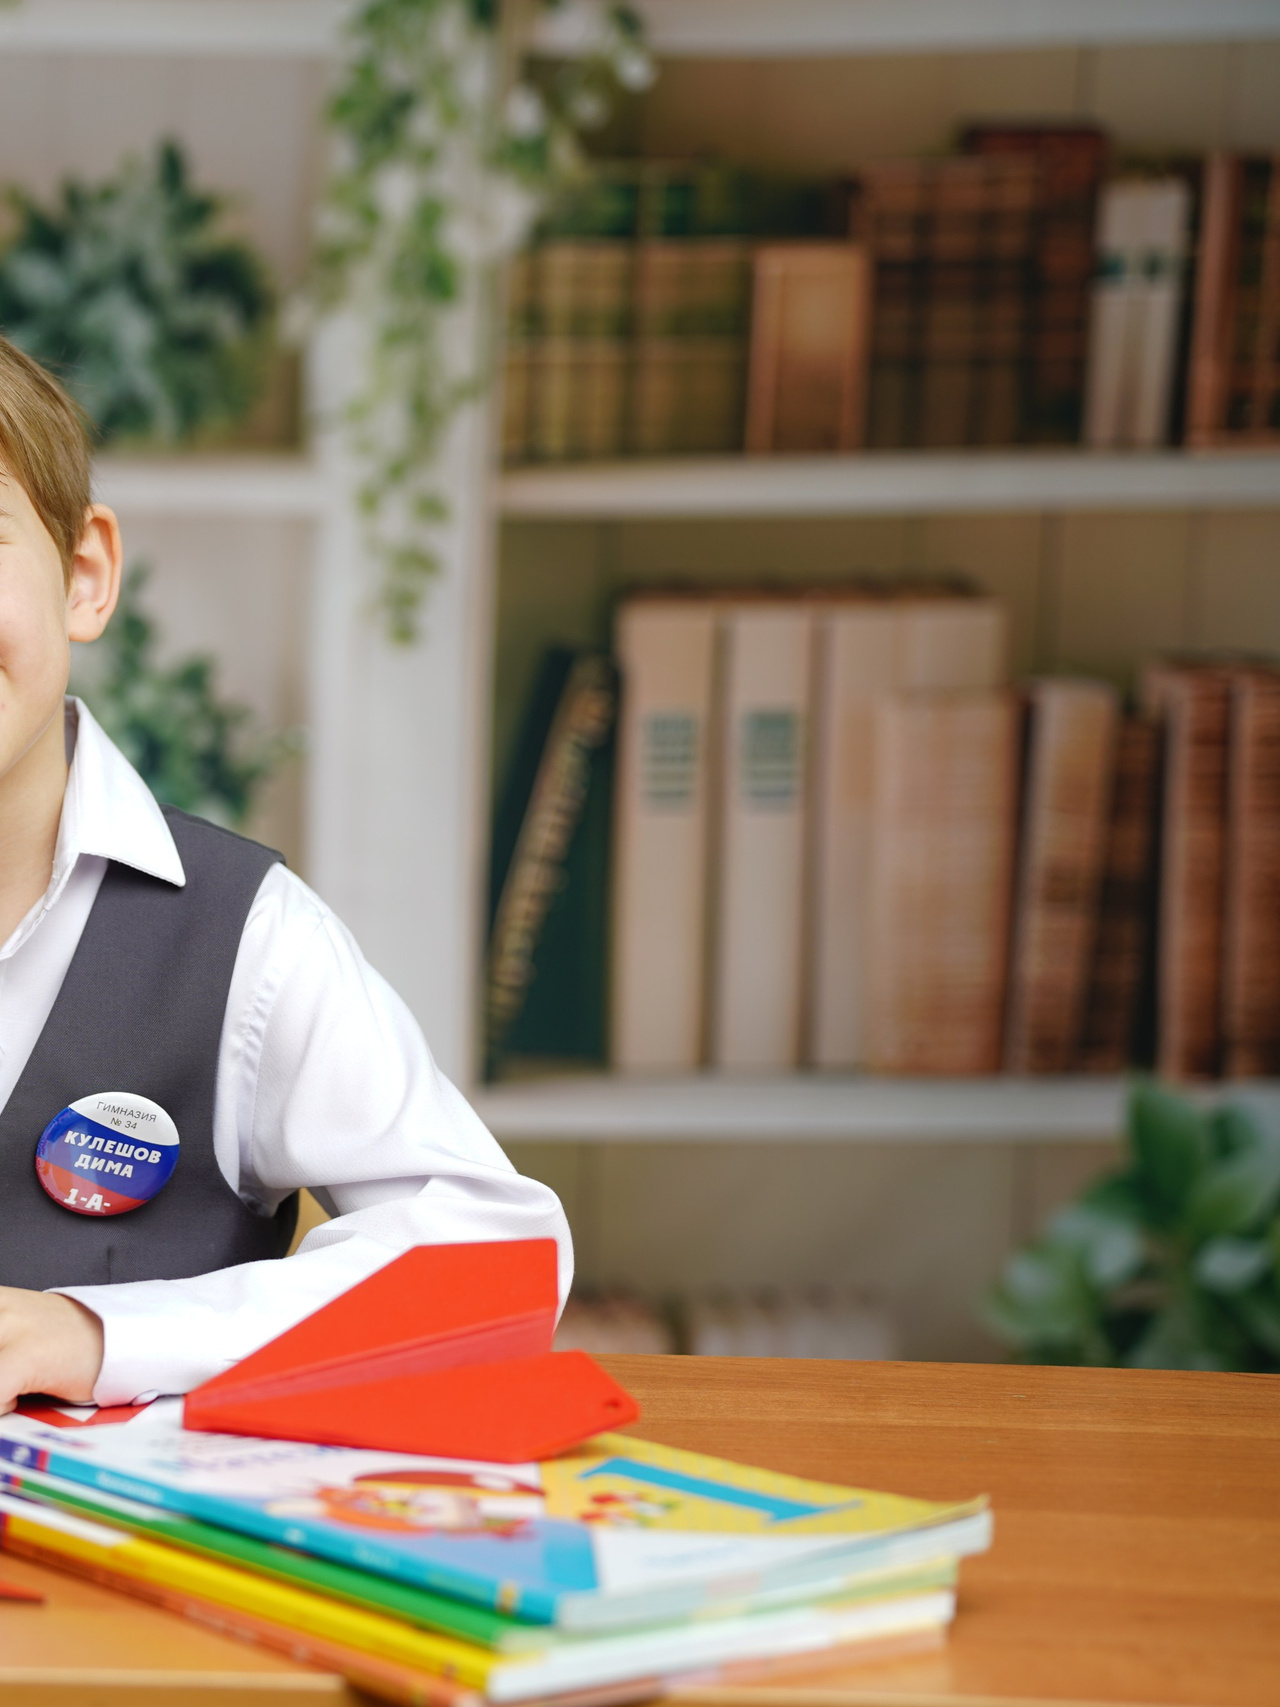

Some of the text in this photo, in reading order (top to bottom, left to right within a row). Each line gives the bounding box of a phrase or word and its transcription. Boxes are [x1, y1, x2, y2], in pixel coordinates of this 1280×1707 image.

[97, 1101, 157, 1122] ГИМНАЗИЯ
[110, 1117, 138, 1130] № 34
[64, 1131, 162, 1164] КУЛЕШОВ
[75, 1154, 133, 1178] ДИМА
